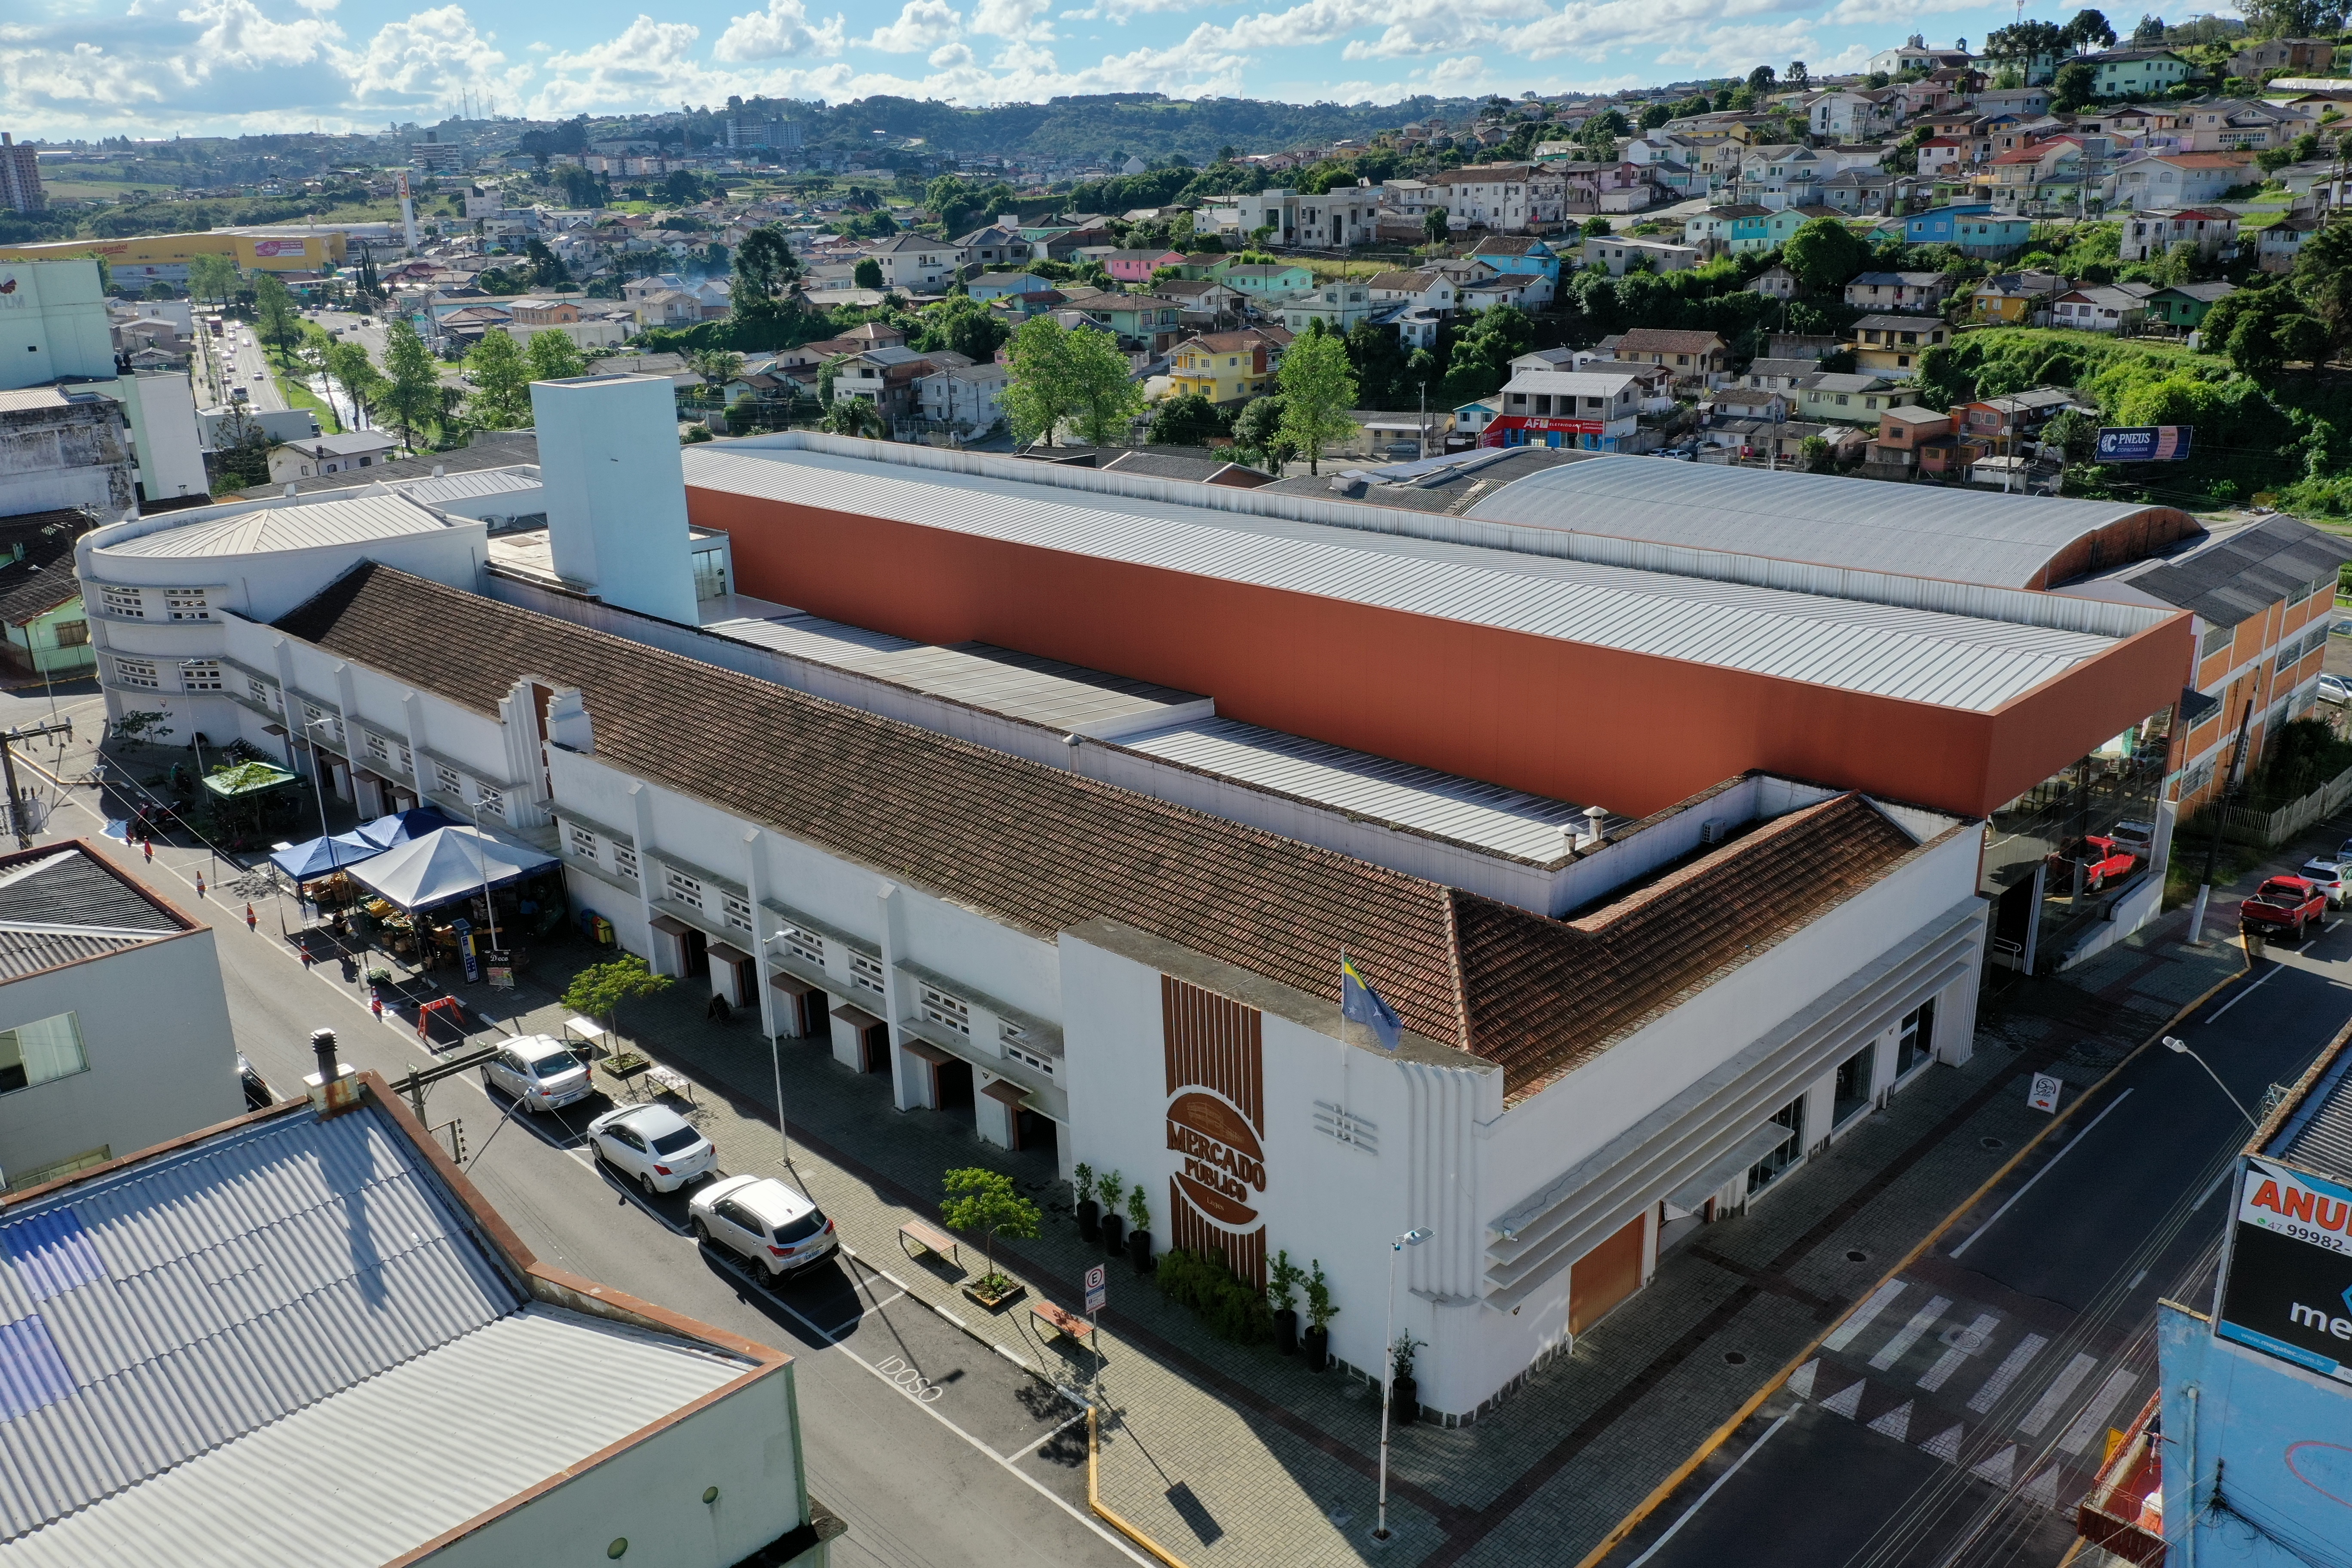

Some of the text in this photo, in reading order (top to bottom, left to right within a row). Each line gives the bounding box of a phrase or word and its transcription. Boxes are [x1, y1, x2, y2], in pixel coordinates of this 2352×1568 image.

[1524, 419, 1540, 428] AF
[2118, 433, 2150, 444] PNEUS
[1167, 1119, 1266, 1193] MERCADO
[1185, 1157, 1247, 1203] PÚBLICO
[1207, 1197, 1224, 1211] Lages
[2251, 1179, 2352, 1237] ANU
[2267, 1222, 2282, 1231] 47
[1092, 1272, 1098, 1284] E
[2241, 1333, 2325, 1366] www.megatec.com.br
[875, 1354, 943, 1402] IDOSO
